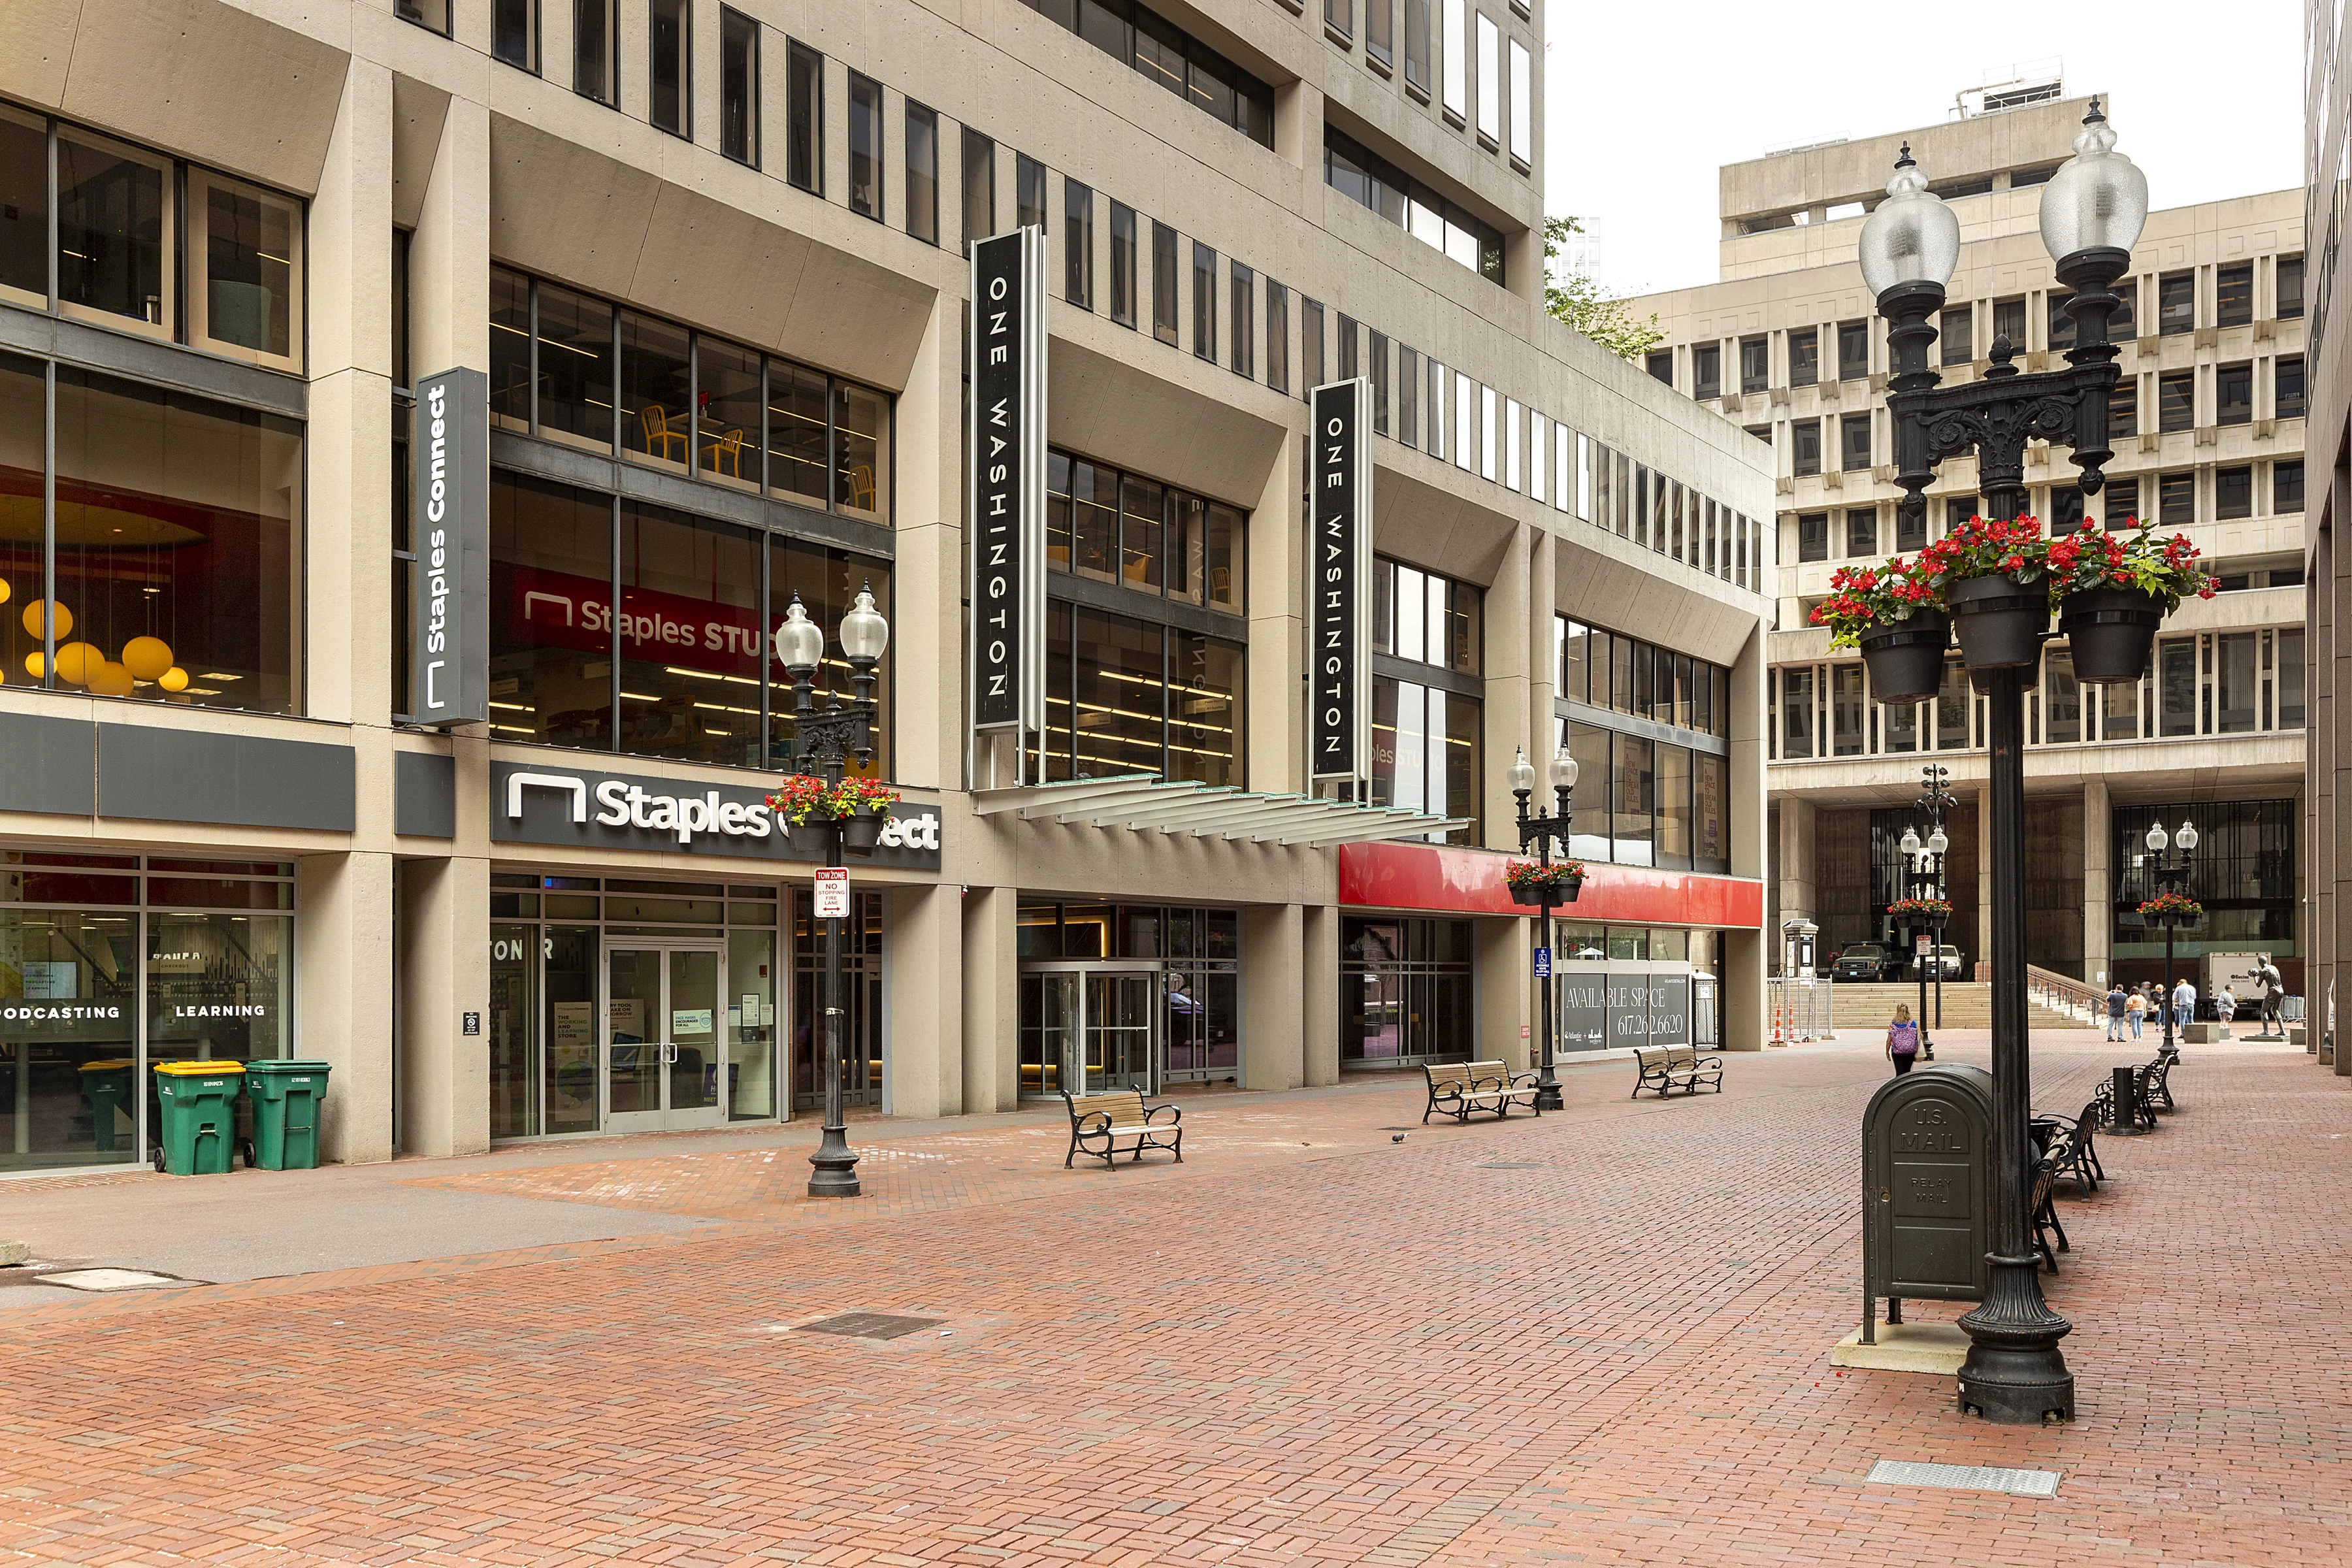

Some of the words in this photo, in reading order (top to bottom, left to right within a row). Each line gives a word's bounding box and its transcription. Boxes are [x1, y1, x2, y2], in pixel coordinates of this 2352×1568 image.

[989, 277, 1007, 366] ONE
[427, 384, 446, 523] Connect
[1328, 417, 1343, 488] ONE
[988, 398, 1007, 696] WASHINGTON
[427, 529, 449, 654] Staples
[581, 600, 696, 646] Staples
[1325, 514, 1343, 753] WASHINGTON
[1625, 767, 1638, 776] SPACE
[595, 780, 771, 843] Staples
[830, 871, 845, 879] ZONE
[1566, 987, 1627, 1008] AVAILABLE
[1631, 987, 1665, 1007] SPACE
[0, 1007, 120, 1020] ODCASTING
[176, 1005, 265, 1017] LEARNING
[1618, 1014, 1683, 1036] 617.262.6620
[1914, 1109, 1947, 1126] U.S.
[1900, 1132, 1961, 1151] MAIL
[1911, 1177, 1952, 1188] RELAY
[1916, 1193, 1948, 1203] MAIL
